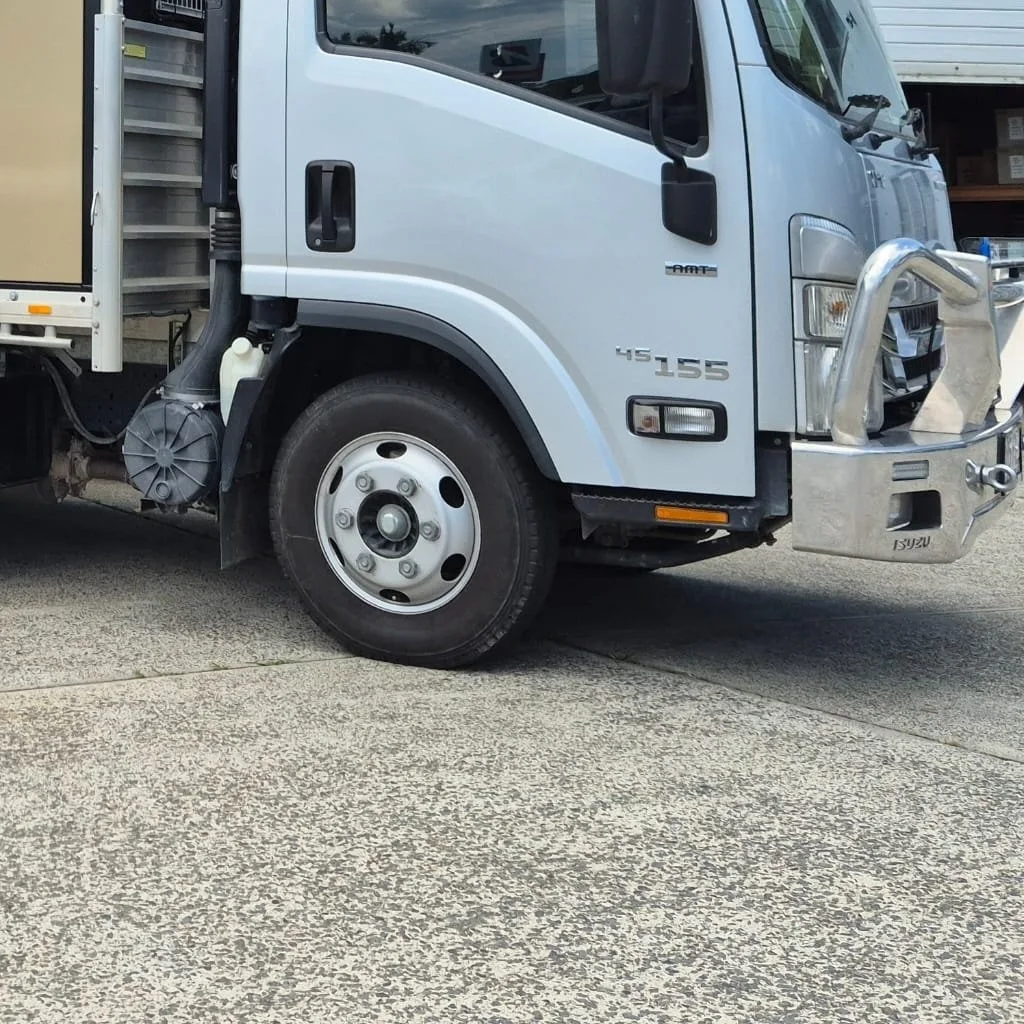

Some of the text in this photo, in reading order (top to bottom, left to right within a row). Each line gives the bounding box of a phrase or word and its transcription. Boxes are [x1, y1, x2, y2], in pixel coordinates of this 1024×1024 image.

[671, 264, 709, 274] AMT
[615, 346, 730, 381] 45 155
[893, 536, 931, 551] ISUZU
